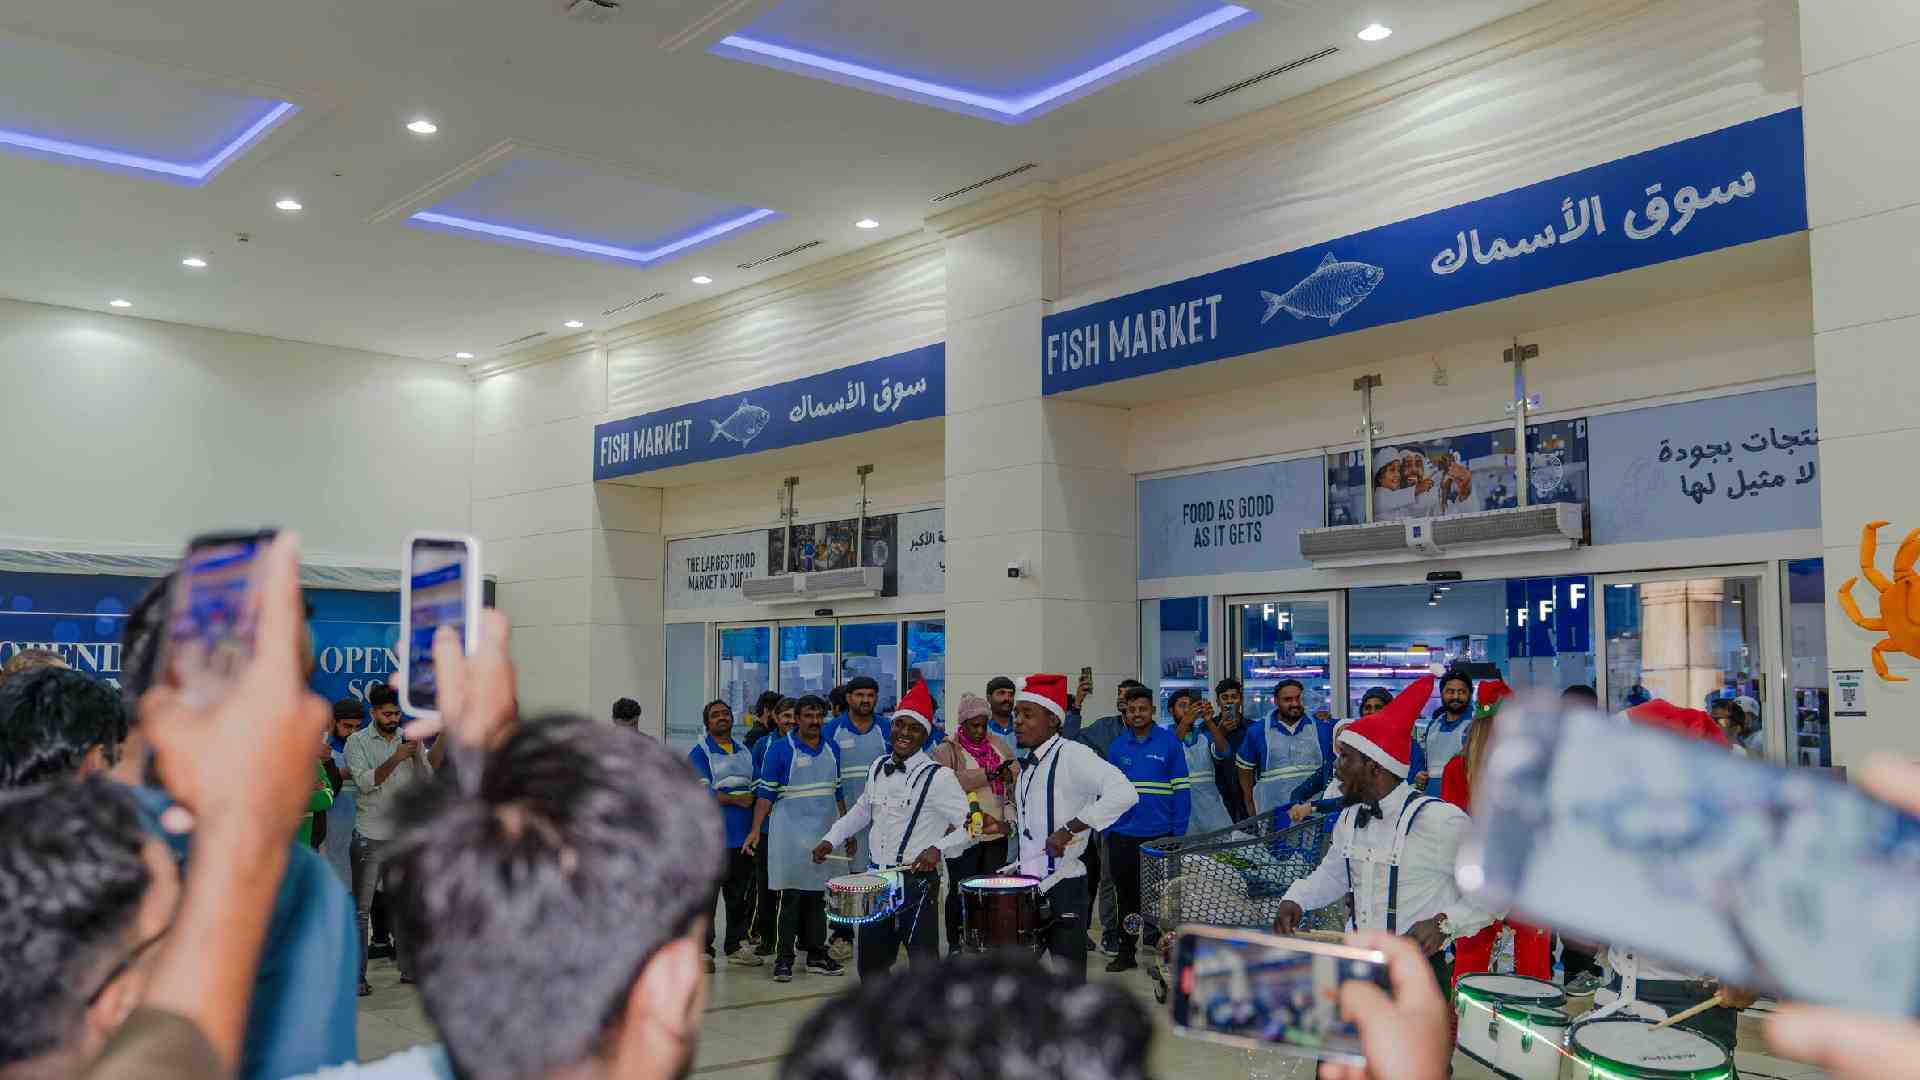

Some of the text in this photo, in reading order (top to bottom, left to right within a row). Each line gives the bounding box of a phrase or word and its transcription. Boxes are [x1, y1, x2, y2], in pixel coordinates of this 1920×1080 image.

[1431, 170, 1757, 275] سوق الأسماك
[1047, 295, 1223, 376] FISH MARKET
[789, 376, 927, 424] سوق الأسماك
[600, 419, 693, 467] FISH MARKET
[1658, 439, 1733, 470] بجودة
[1680, 461, 1818, 505] لا مثيل لها
[1182, 494, 1275, 525] FOOD AS GOOD
[1194, 521, 1263, 548] AS IT GETS
[687, 552, 756, 573] THE LARGEST FOOD
[688, 574, 718, 591] MARKET
[720, 573, 728, 588] IN
[1540, 600, 1552, 621] F
[1570, 584, 1585, 609] F
[1264, 603, 1275, 621] F
[1278, 612, 1289, 630] F
[320, 646, 400, 674] OPEN
